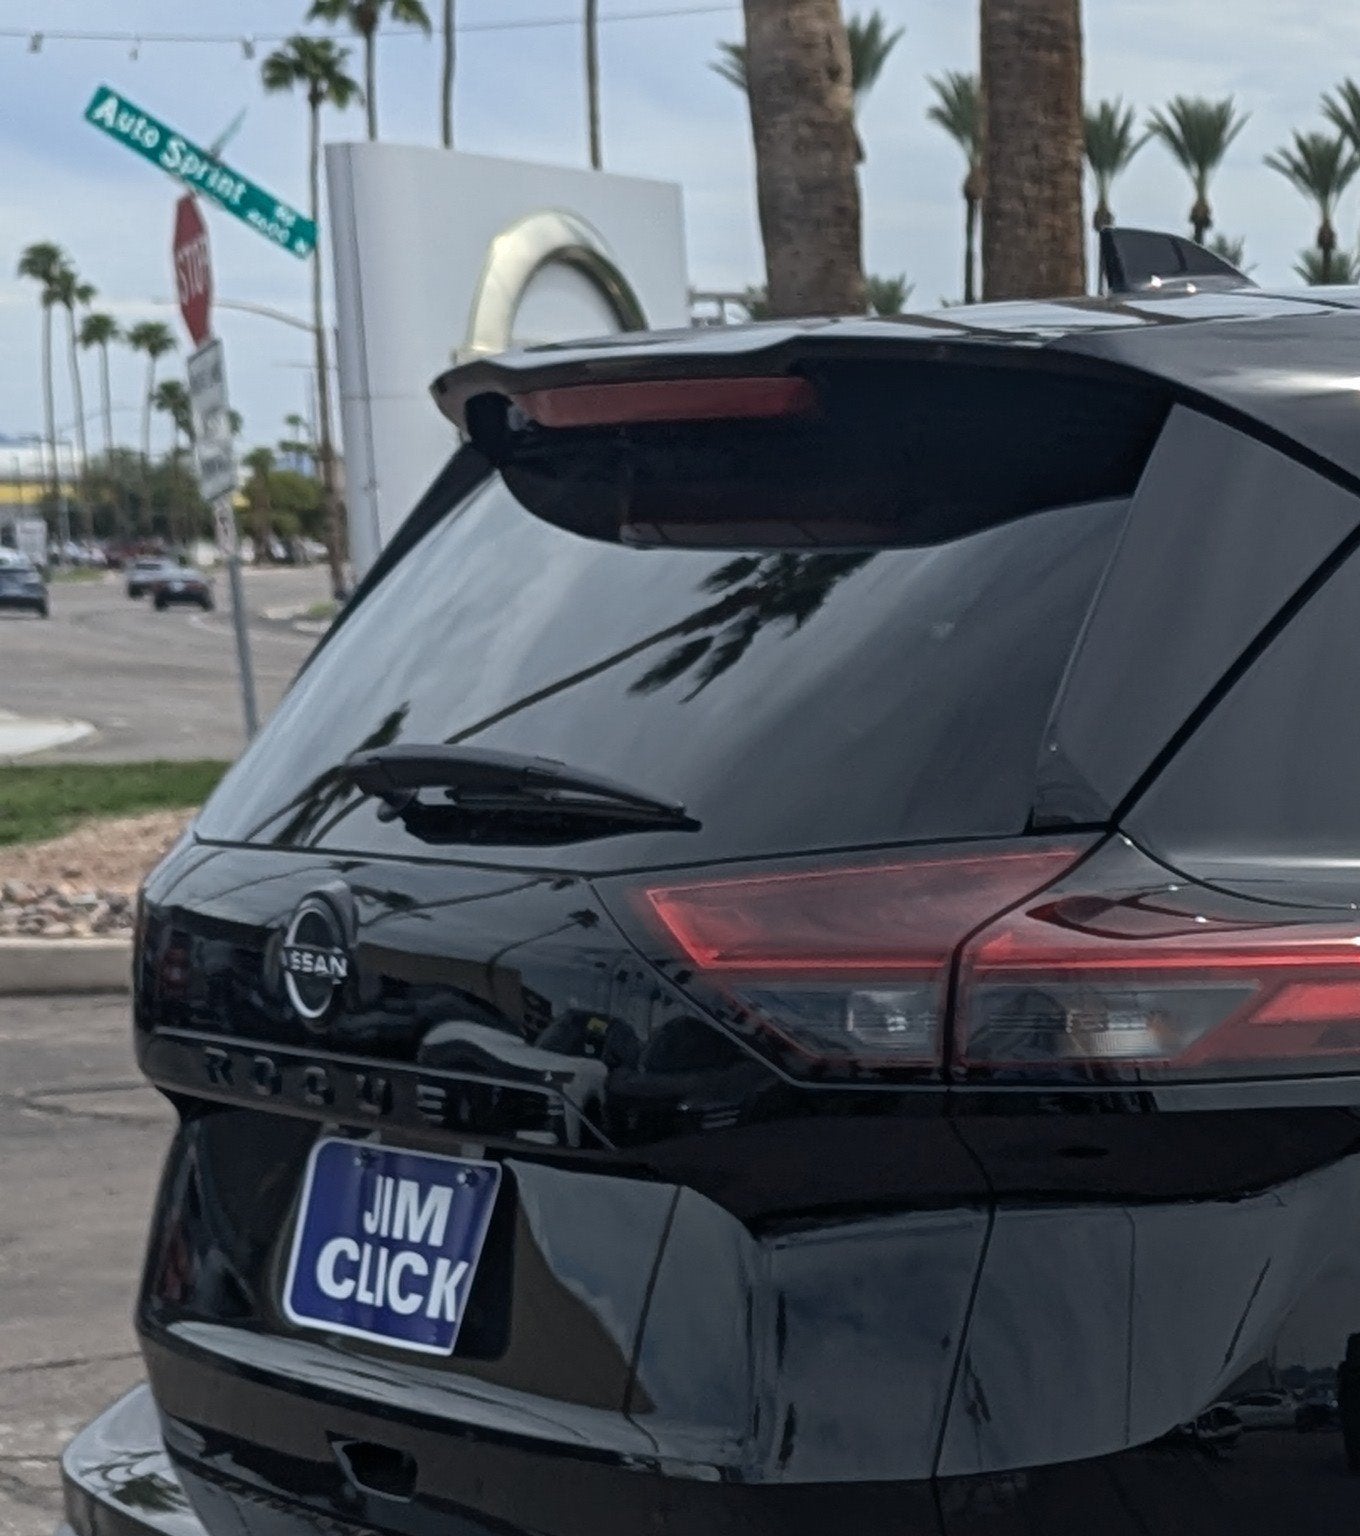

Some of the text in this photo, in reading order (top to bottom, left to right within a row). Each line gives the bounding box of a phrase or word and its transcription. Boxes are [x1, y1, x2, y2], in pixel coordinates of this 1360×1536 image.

[91, 96, 247, 205] Auto Sprint
[203, 1045, 447, 1123] ROGUE
[362, 1173, 454, 1248] JIM
[315, 1236, 470, 1323] CLICK
